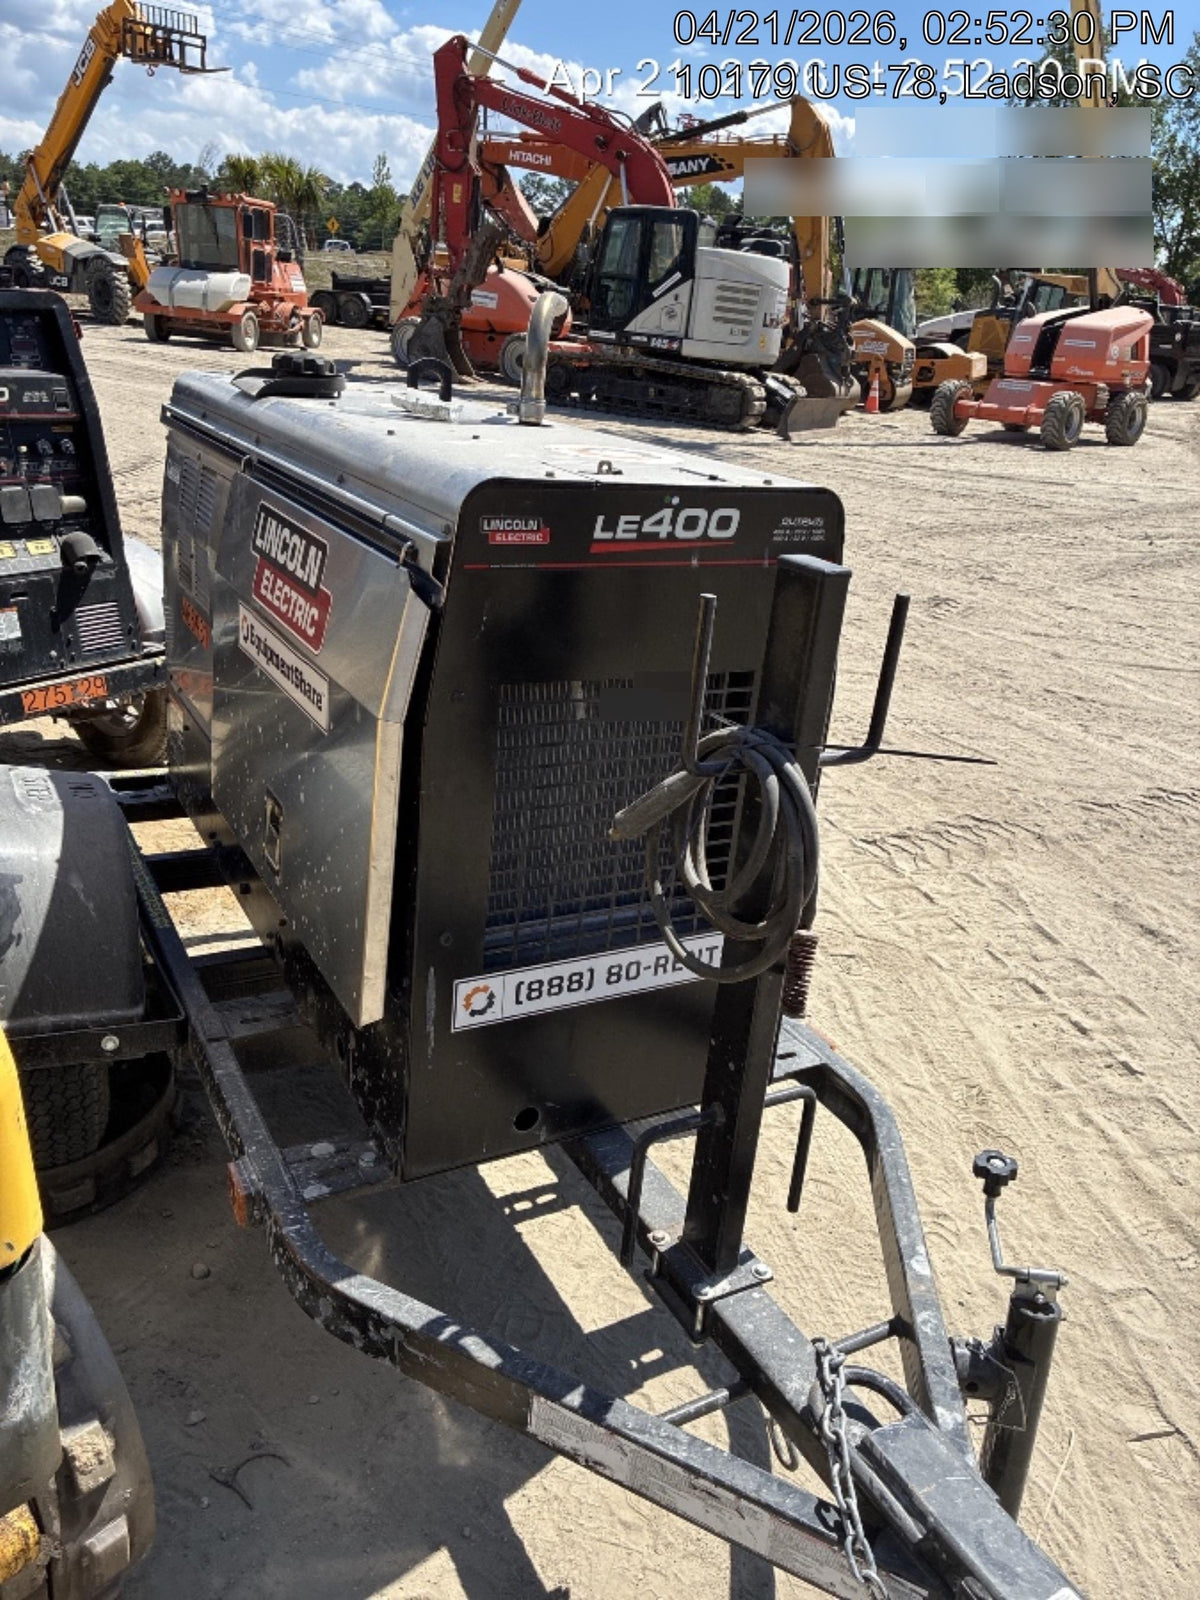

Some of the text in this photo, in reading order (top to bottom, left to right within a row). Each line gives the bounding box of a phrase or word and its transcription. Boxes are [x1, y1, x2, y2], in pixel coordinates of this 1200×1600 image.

[74, 39, 95, 86] JCB
[508, 149, 552, 166] HITACHI
[666, 157, 710, 176] SANY
[49, 275, 68, 287] JCB
[482, 518, 538, 531] LINCOLN
[495, 532, 544, 542] ELECTRIC
[593, 507, 741, 539] LE400
[255, 511, 322, 590] LINCOLN
[260, 567, 320, 637] ELECTRIC
[249, 622, 323, 712] EquipmentShare
[514, 966, 595, 1005] (888)
